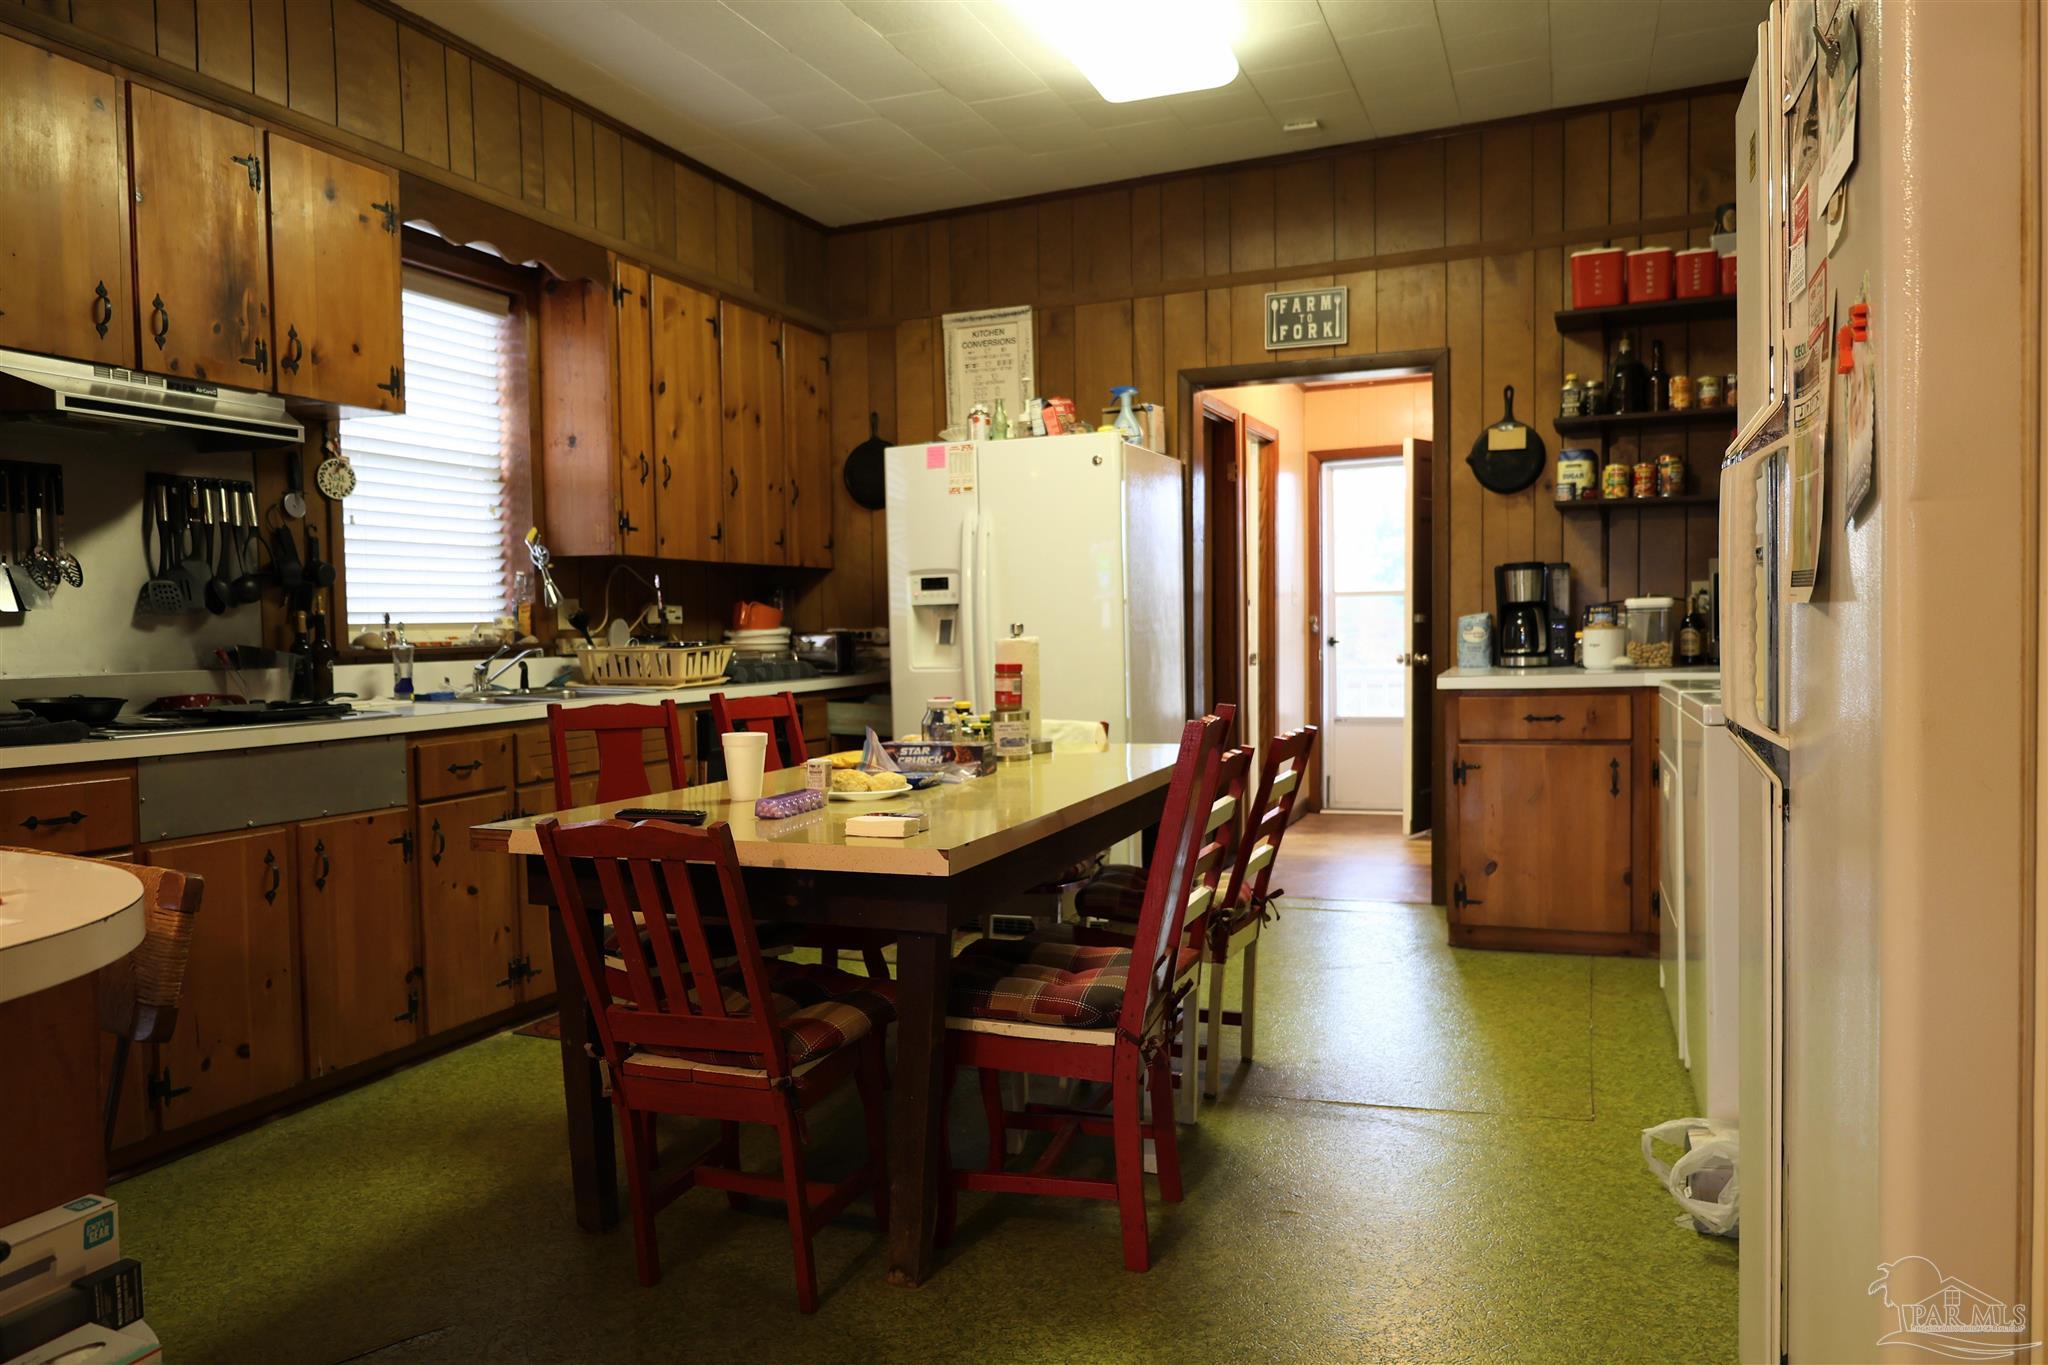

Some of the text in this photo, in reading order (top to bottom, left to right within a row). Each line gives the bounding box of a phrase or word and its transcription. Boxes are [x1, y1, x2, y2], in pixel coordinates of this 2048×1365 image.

[1279, 295, 1332, 314] FARM
[1299, 313, 1313, 323] TO
[972, 328, 1006, 338] KITCHEN
[1279, 321, 1334, 341] FORK
[961, 337, 1017, 349] CONVERSIONS
[899, 746, 931, 756] STAR
[897, 754, 944, 765] CRUNCH
